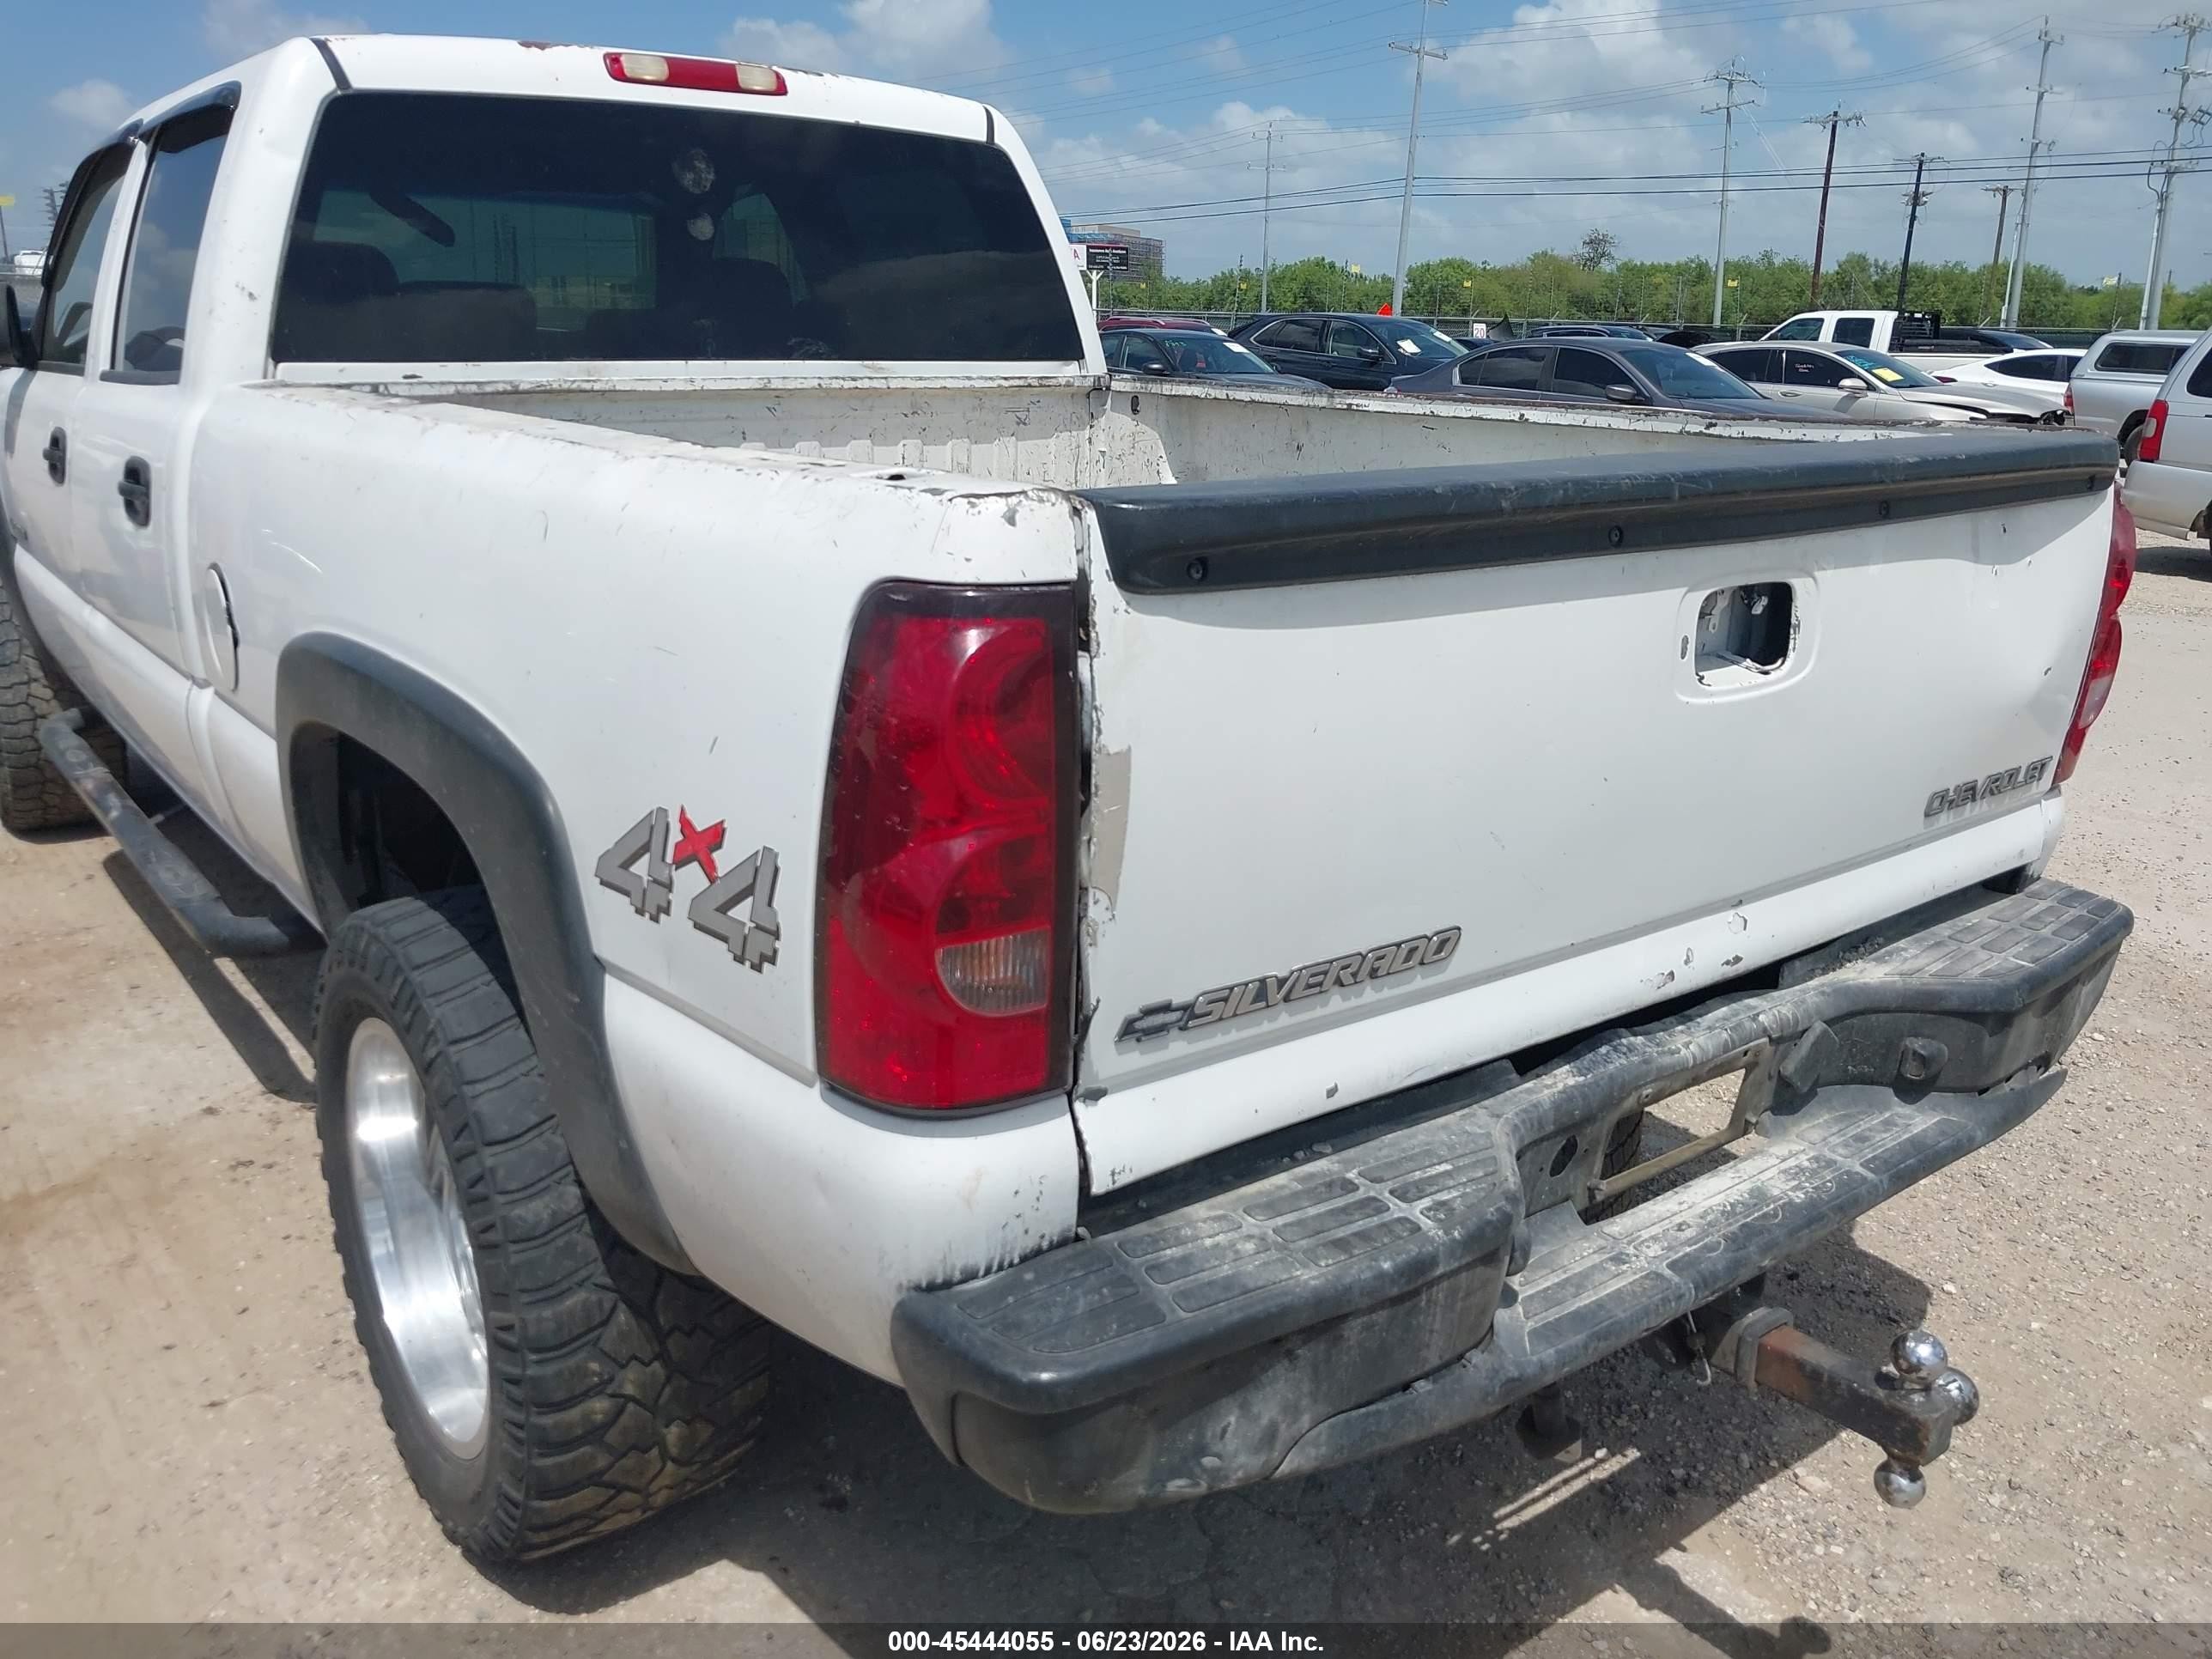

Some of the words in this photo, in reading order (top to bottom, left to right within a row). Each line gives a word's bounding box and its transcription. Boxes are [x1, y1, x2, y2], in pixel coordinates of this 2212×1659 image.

[1474, 327, 1485, 338] 20
[1923, 755, 2054, 818] CHEVROLET
[1182, 925, 1462, 1031] SILVERADO
